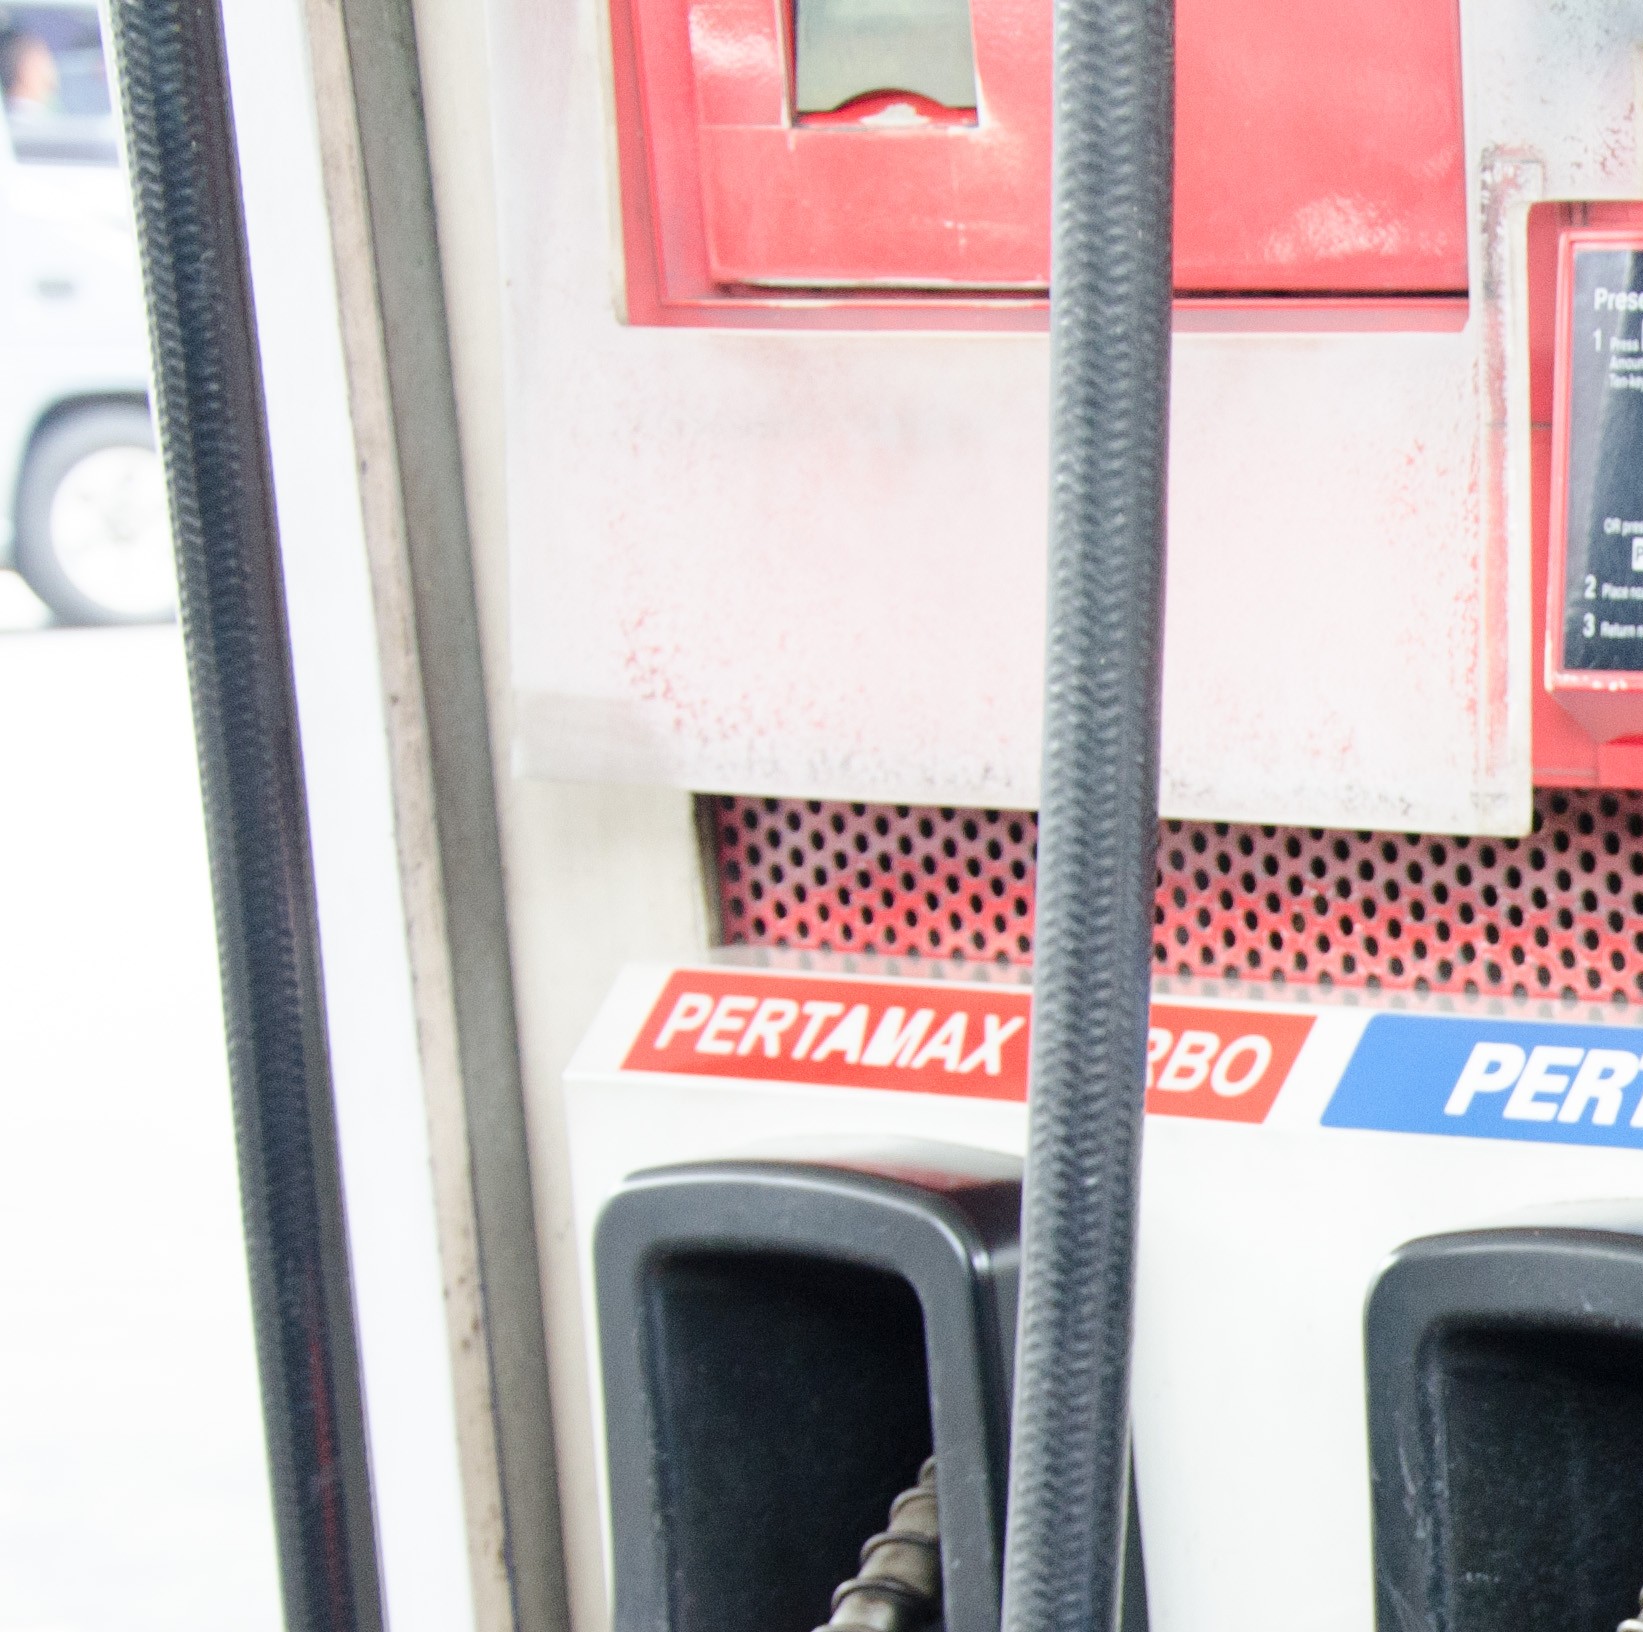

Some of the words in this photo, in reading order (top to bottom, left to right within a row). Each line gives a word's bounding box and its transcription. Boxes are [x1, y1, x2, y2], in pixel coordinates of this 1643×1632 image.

[1593, 328, 1603, 352] 1
[1603, 517, 1622, 535] OR
[1584, 573, 1598, 600] 2
[1582, 612, 1596, 639] 3
[654, 992, 1026, 1076] PERTAMAX
[1146, 1027, 1273, 1098] RBO
